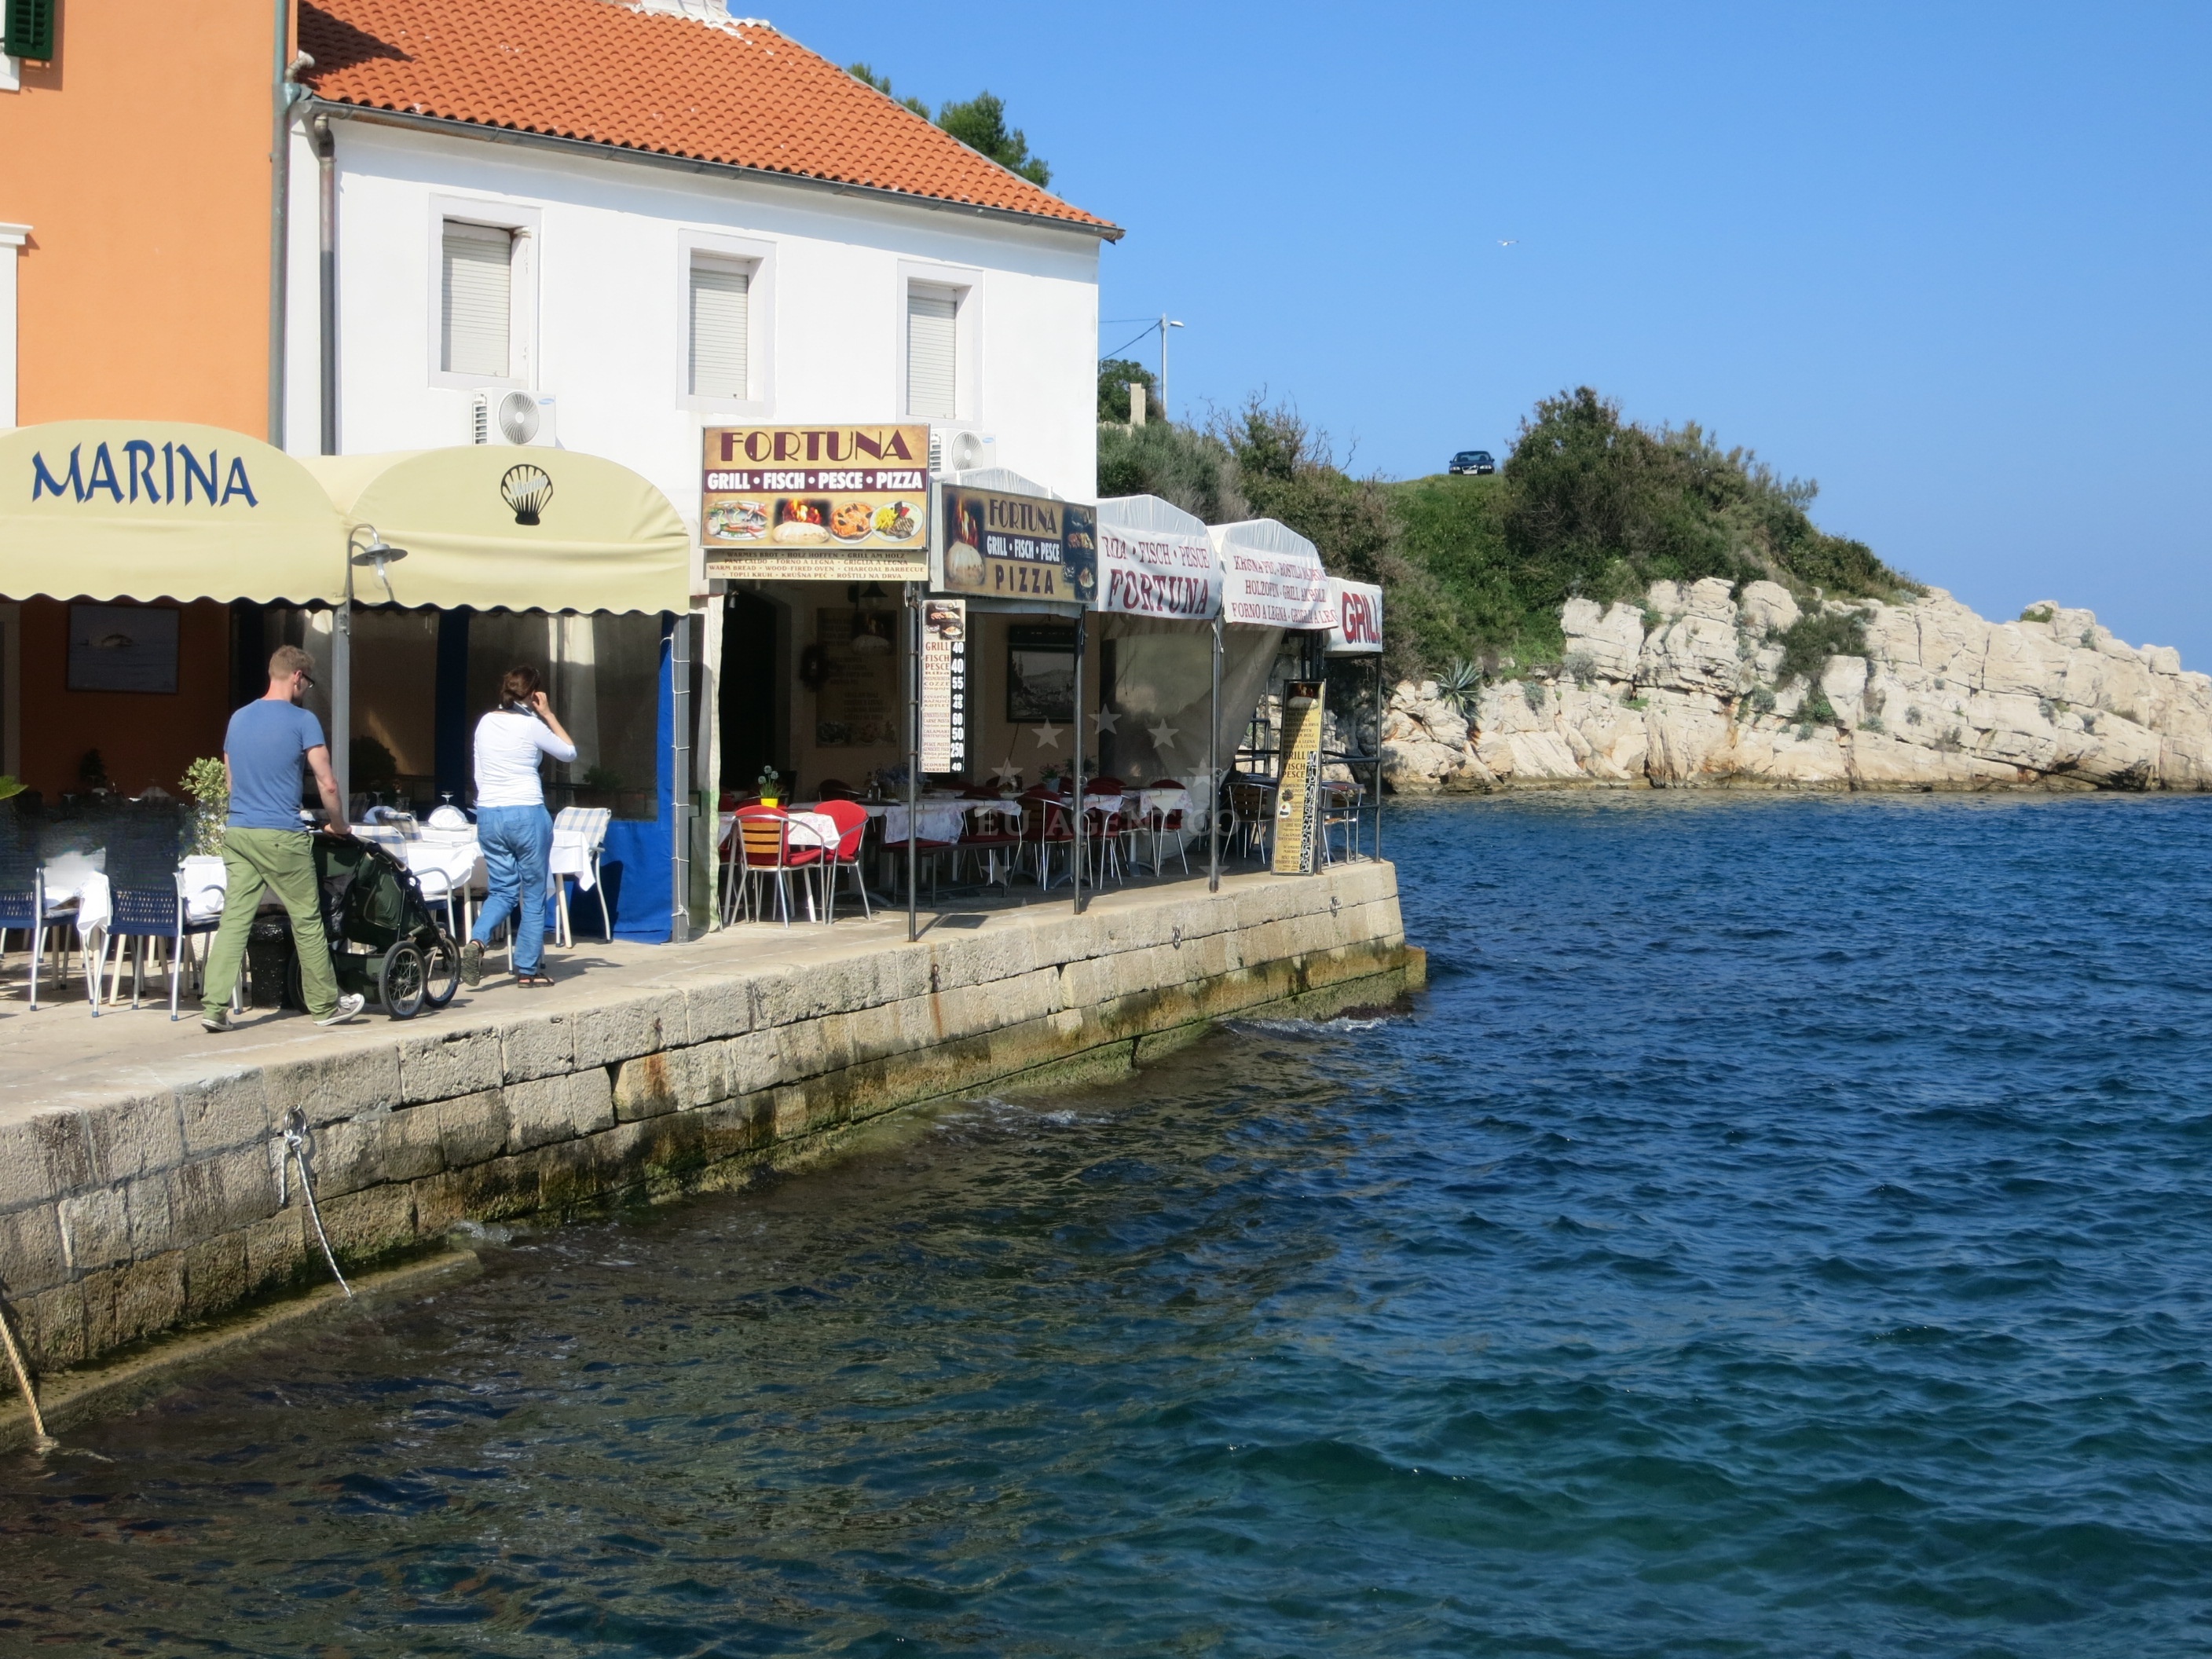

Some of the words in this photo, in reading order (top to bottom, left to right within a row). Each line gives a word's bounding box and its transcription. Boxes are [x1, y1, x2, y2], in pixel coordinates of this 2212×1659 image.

[720, 429, 913, 462] FORTUNA
[31, 439, 259, 508] MARINA
[708, 472, 751, 490] GRILL
[763, 472, 806, 490] FISCH
[818, 471, 863, 489] PESCE
[876, 471, 923, 489] PIZZA
[990, 499, 1057, 534] FORTUNA
[987, 535, 1008, 556] GRILL
[1014, 538, 1035, 559] FISCH
[1040, 541, 1060, 562] PESCE
[1138, 541, 1172, 565] FISCH
[1178, 545, 1210, 569] PESCE
[995, 564, 1054, 595] PIZZA
[1108, 568, 1208, 614] FORTUNA
[1245, 580, 1280, 598] HOLZOFEN
[1283, 584, 1300, 601] GRILL
[1232, 602, 1261, 619] FORNO
[1262, 604, 1267, 619] A
[1268, 605, 1287, 621] LEGNA
[1313, 609, 1318, 624] A
[1342, 591, 1381, 644] GRILL
[925, 641, 949, 650] GRILL
[952, 642, 964, 654] 40
[951, 658, 964, 673] 40
[952, 676, 964, 690] 55
[952, 701, 963, 709] 45
[952, 712, 963, 726] 60
[951, 727, 963, 741] 50
[950, 742, 964, 758] 250
[1284, 751, 1306, 760] GRILL
[951, 762, 962, 771] 40
